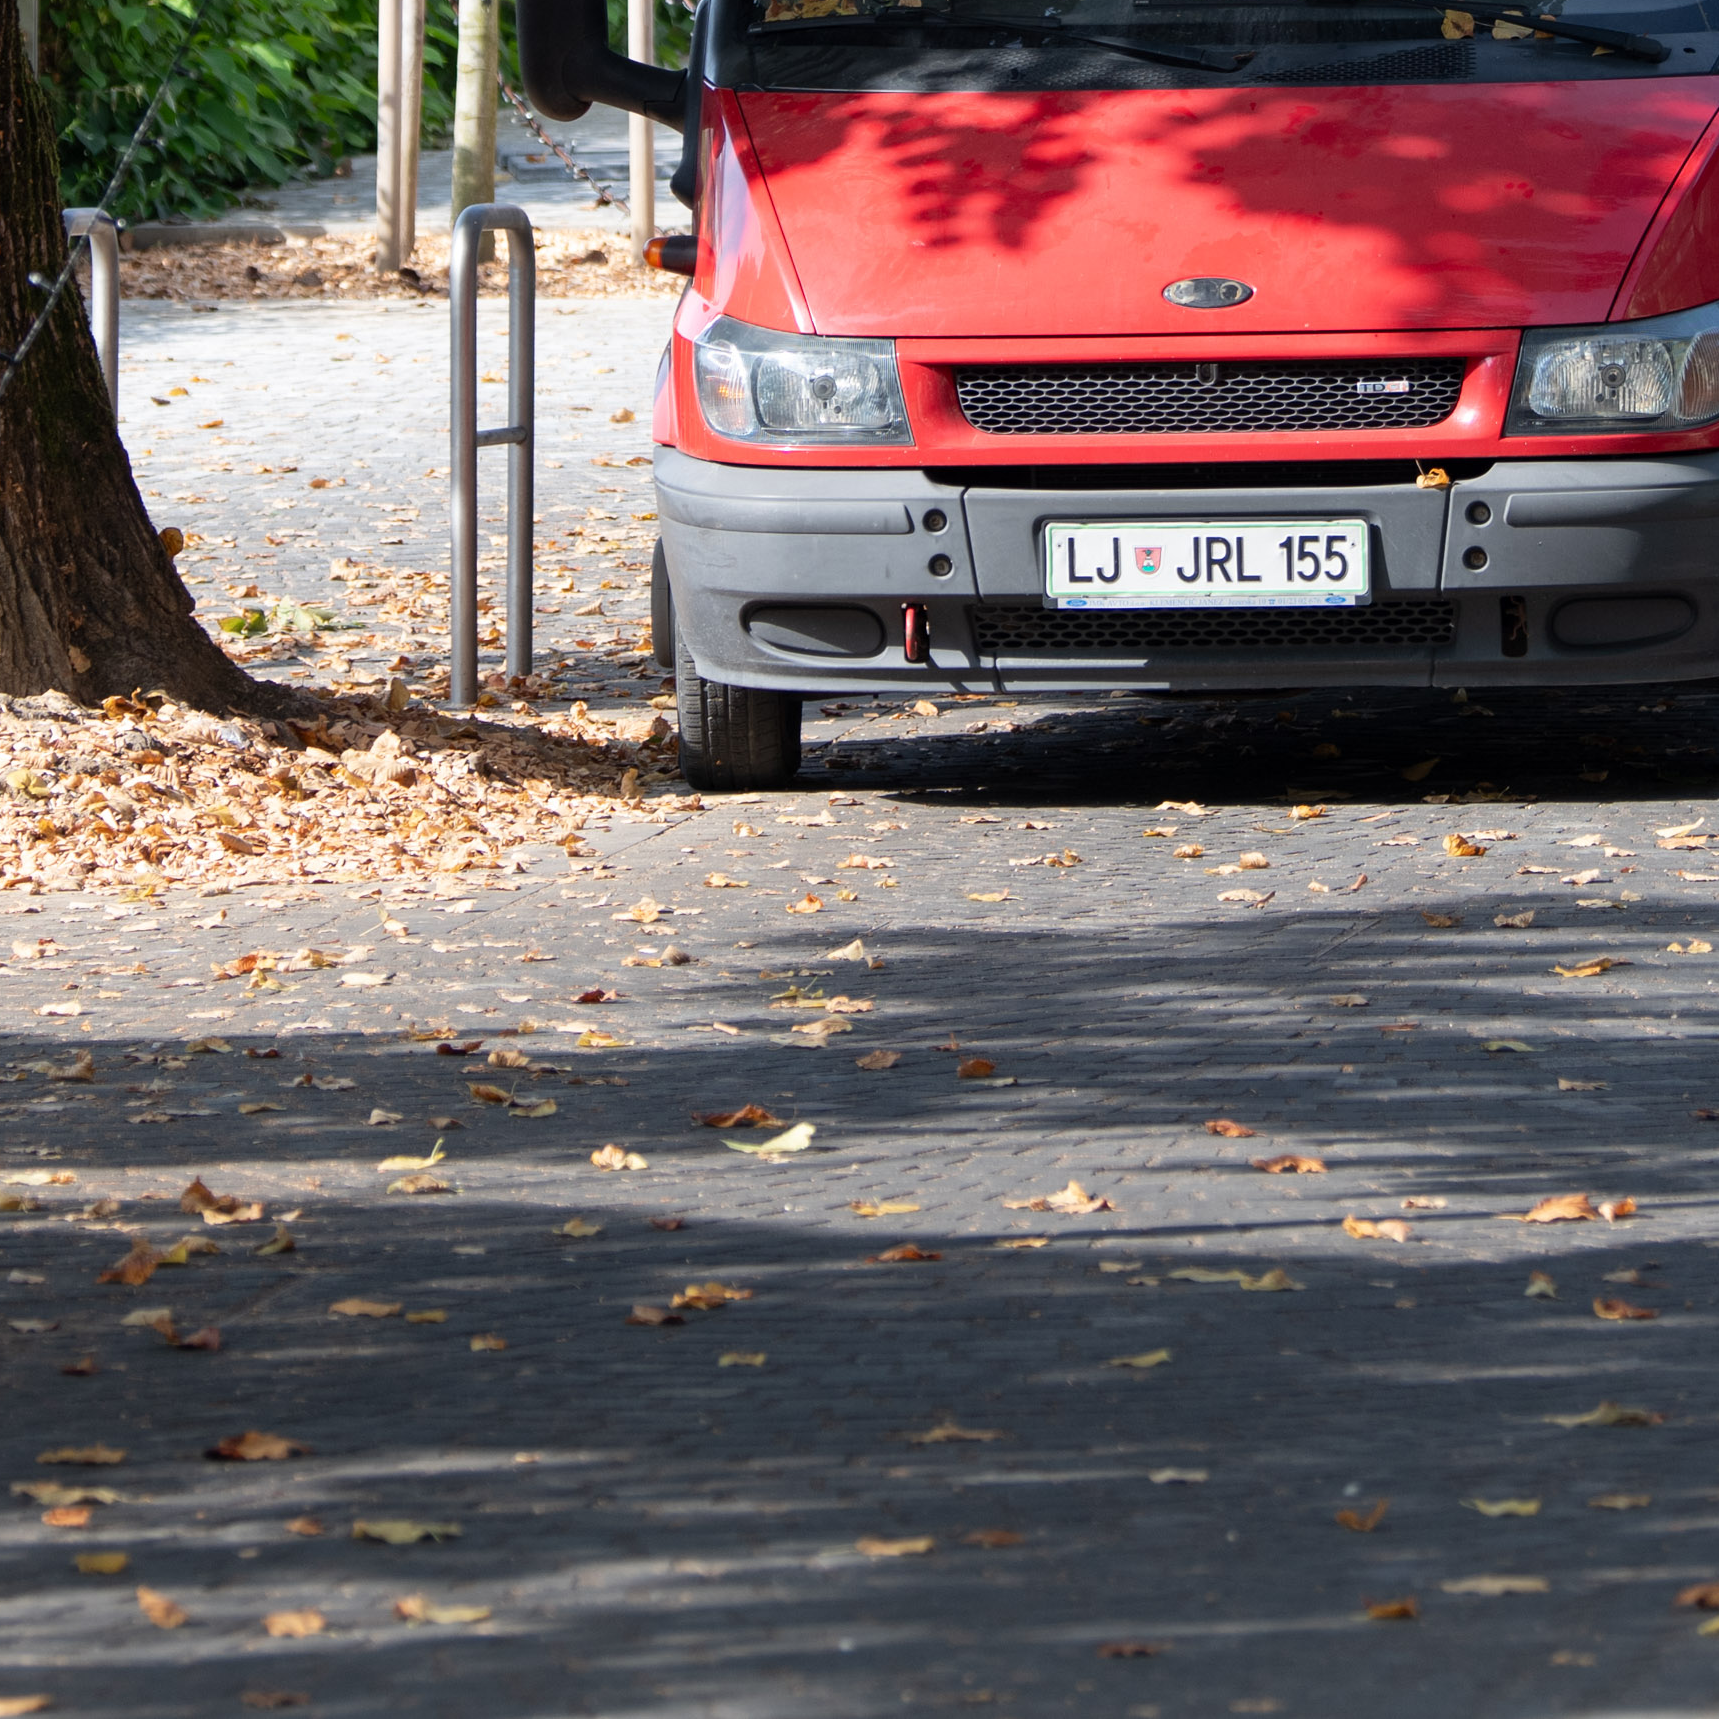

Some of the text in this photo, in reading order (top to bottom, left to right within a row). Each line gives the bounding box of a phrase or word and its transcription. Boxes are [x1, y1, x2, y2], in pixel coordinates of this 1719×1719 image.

[1067, 534, 1349, 583] LJ JRL 155
